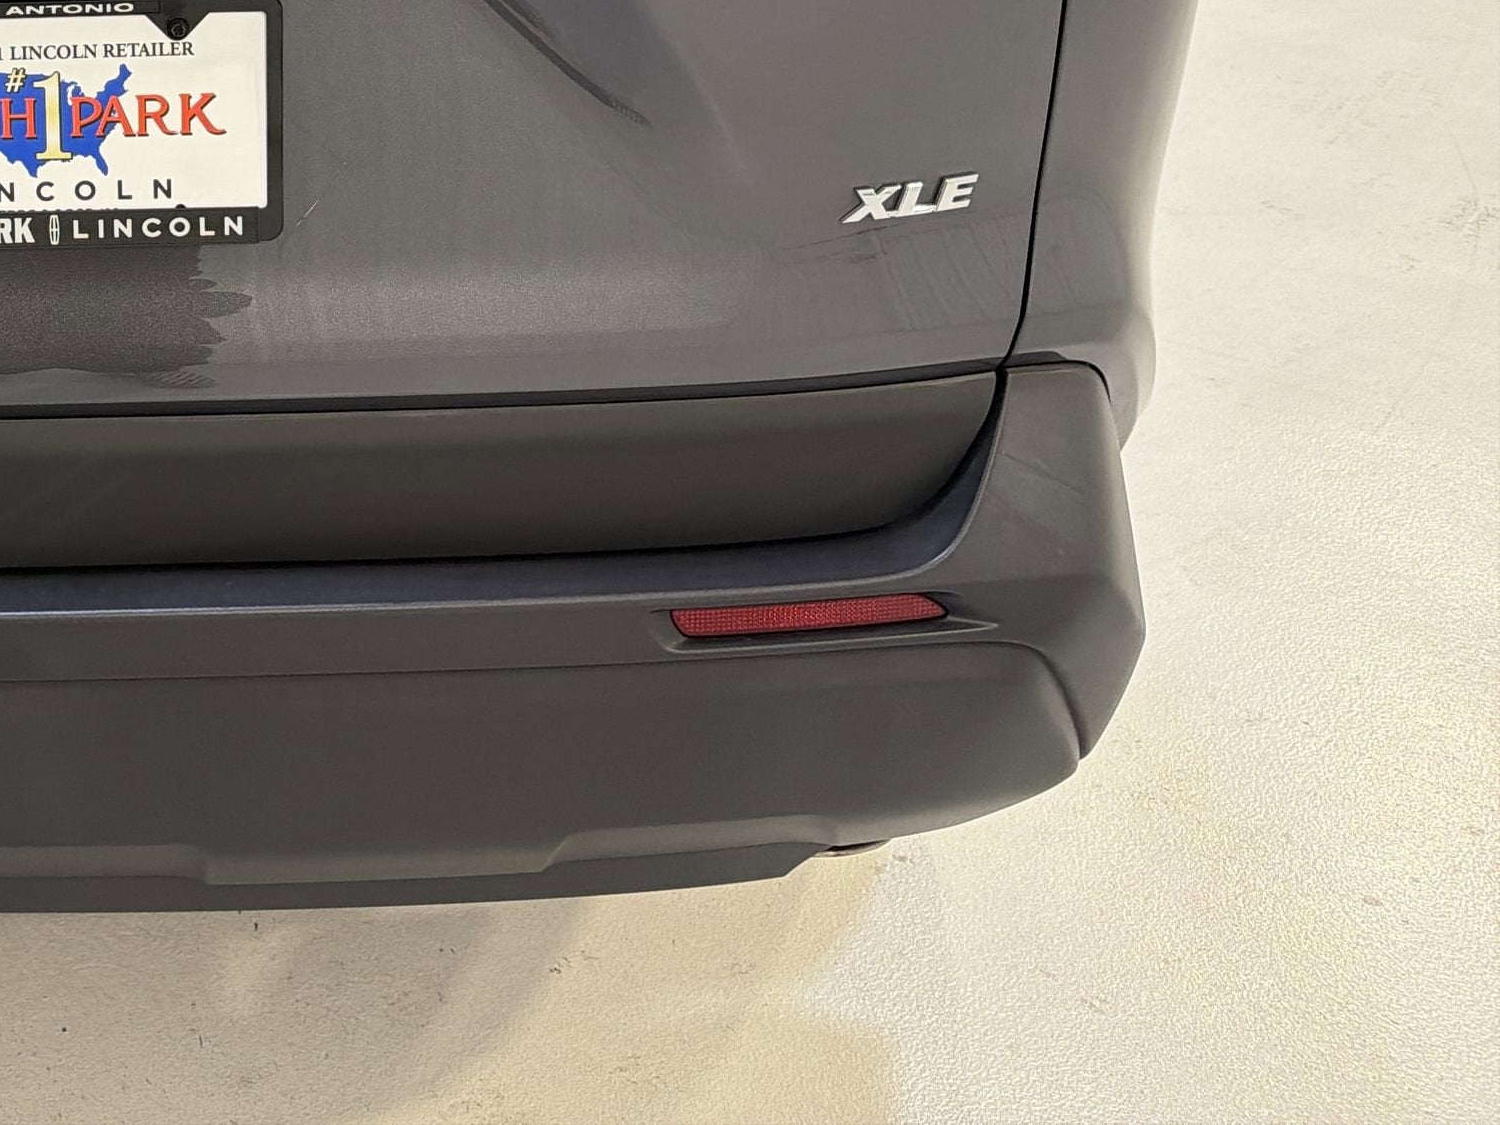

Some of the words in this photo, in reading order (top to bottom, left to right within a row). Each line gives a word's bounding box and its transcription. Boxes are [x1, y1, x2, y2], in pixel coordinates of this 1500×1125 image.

[5, 3, 134, 16] ANTONIO
[9, 44, 98, 61] LINCOLN
[102, 41, 195, 58] RETAILER
[69, 92, 228, 139] PARK
[841, 173, 979, 224] XLE
[72, 215, 244, 240] LINCOLN
